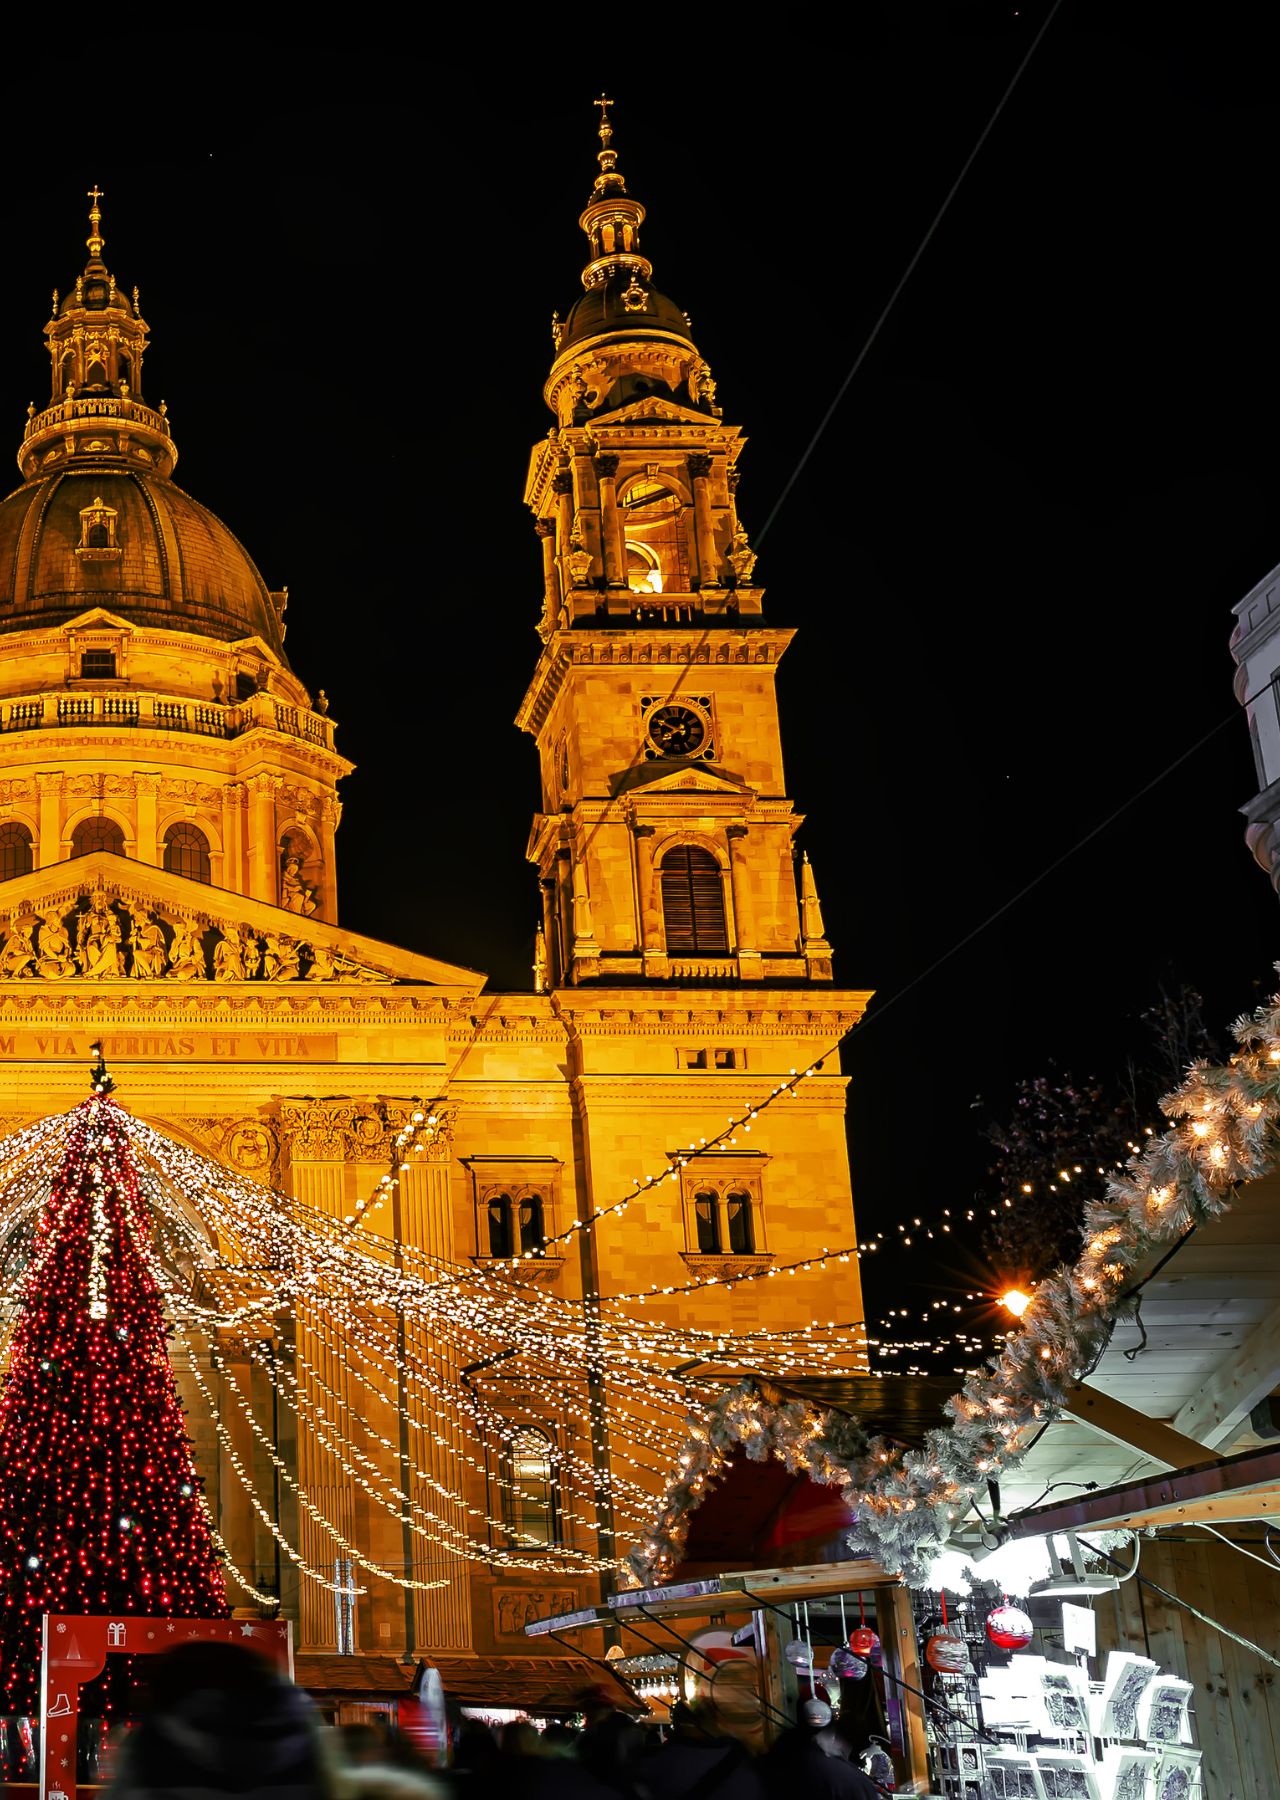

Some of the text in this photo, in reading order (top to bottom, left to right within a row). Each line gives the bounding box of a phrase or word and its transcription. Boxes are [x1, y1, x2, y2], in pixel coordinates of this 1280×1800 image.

[34, 1035, 79, 1055] VIA
[210, 1036, 241, 1057] ET
[255, 1036, 310, 1057] VITA
